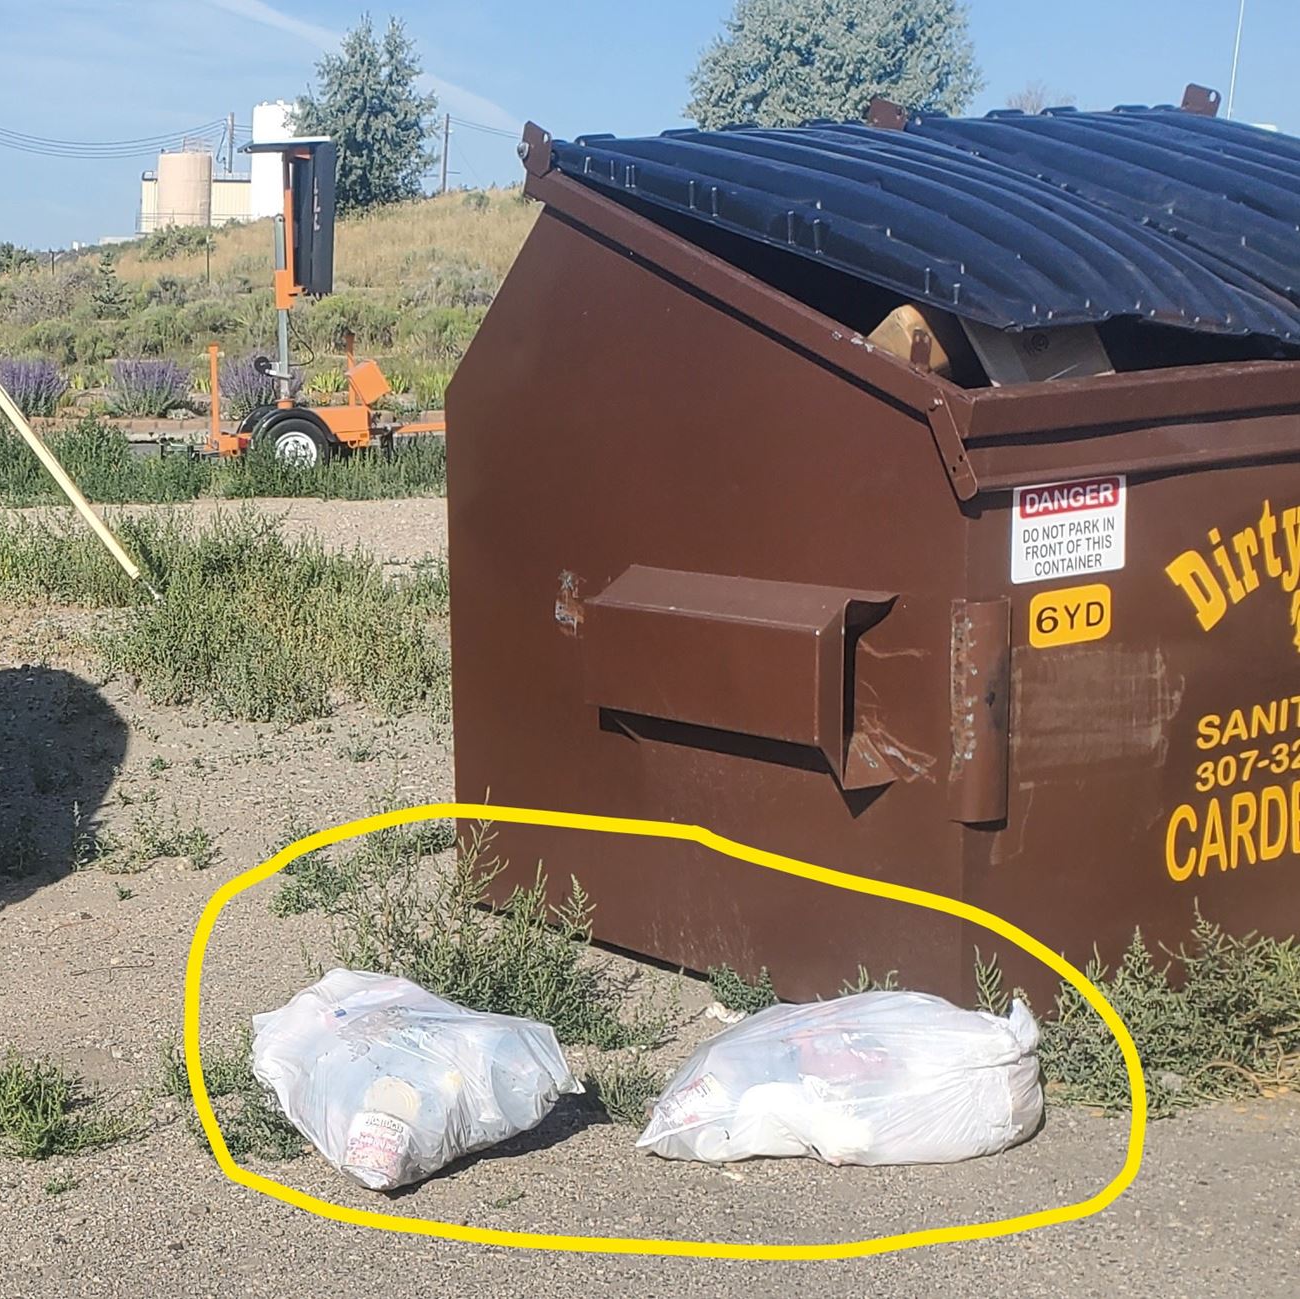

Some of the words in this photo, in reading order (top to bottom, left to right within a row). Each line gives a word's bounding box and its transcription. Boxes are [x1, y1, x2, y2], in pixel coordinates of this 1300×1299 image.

[1025, 483, 1114, 514] DANGER
[1023, 528, 1039, 544] DO
[1042, 523, 1066, 540] NOT
[1069, 518, 1100, 537] PARK
[1103, 516, 1115, 532] IN
[1025, 539, 1064, 561] FRONT
[1066, 537, 1083, 554] OF
[1085, 534, 1112, 551] THIS
[1034, 553, 1102, 577] CONTAINER
[1036, 601, 1104, 633] 6YD
